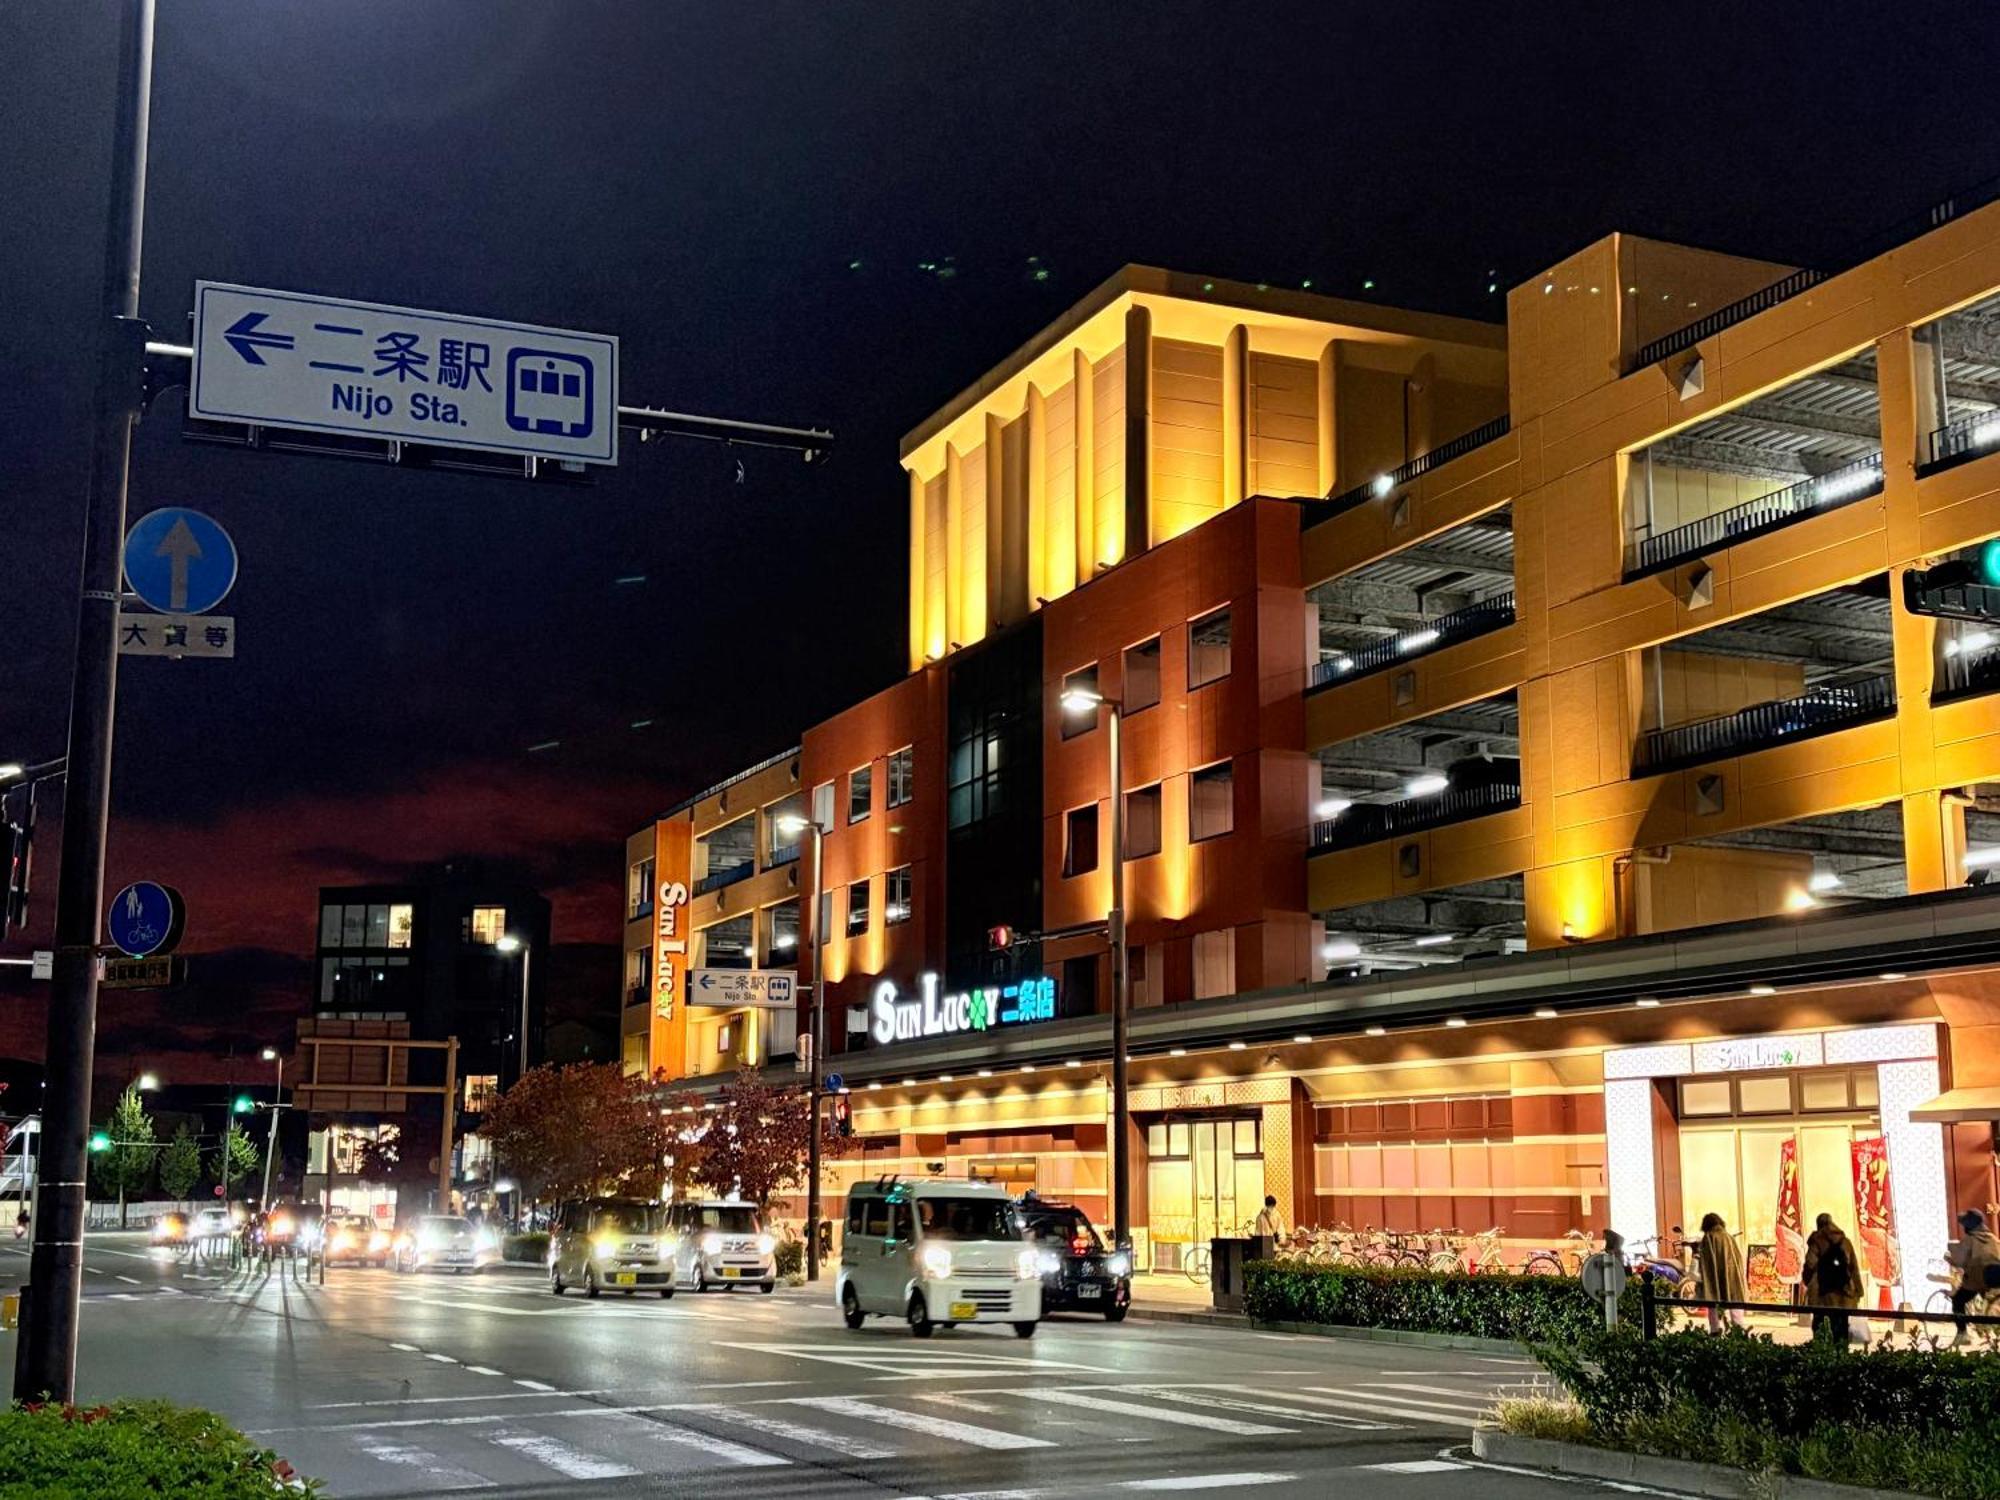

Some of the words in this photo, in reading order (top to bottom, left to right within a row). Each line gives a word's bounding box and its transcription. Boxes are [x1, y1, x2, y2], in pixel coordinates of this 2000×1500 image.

[309, 321, 495, 394] 二条駅
[331, 383, 393, 420] Nijo
[410, 391, 467, 427] Sta.
[720, 975, 765, 991] 二条駅
[1002, 976, 1055, 1023] 二条店
